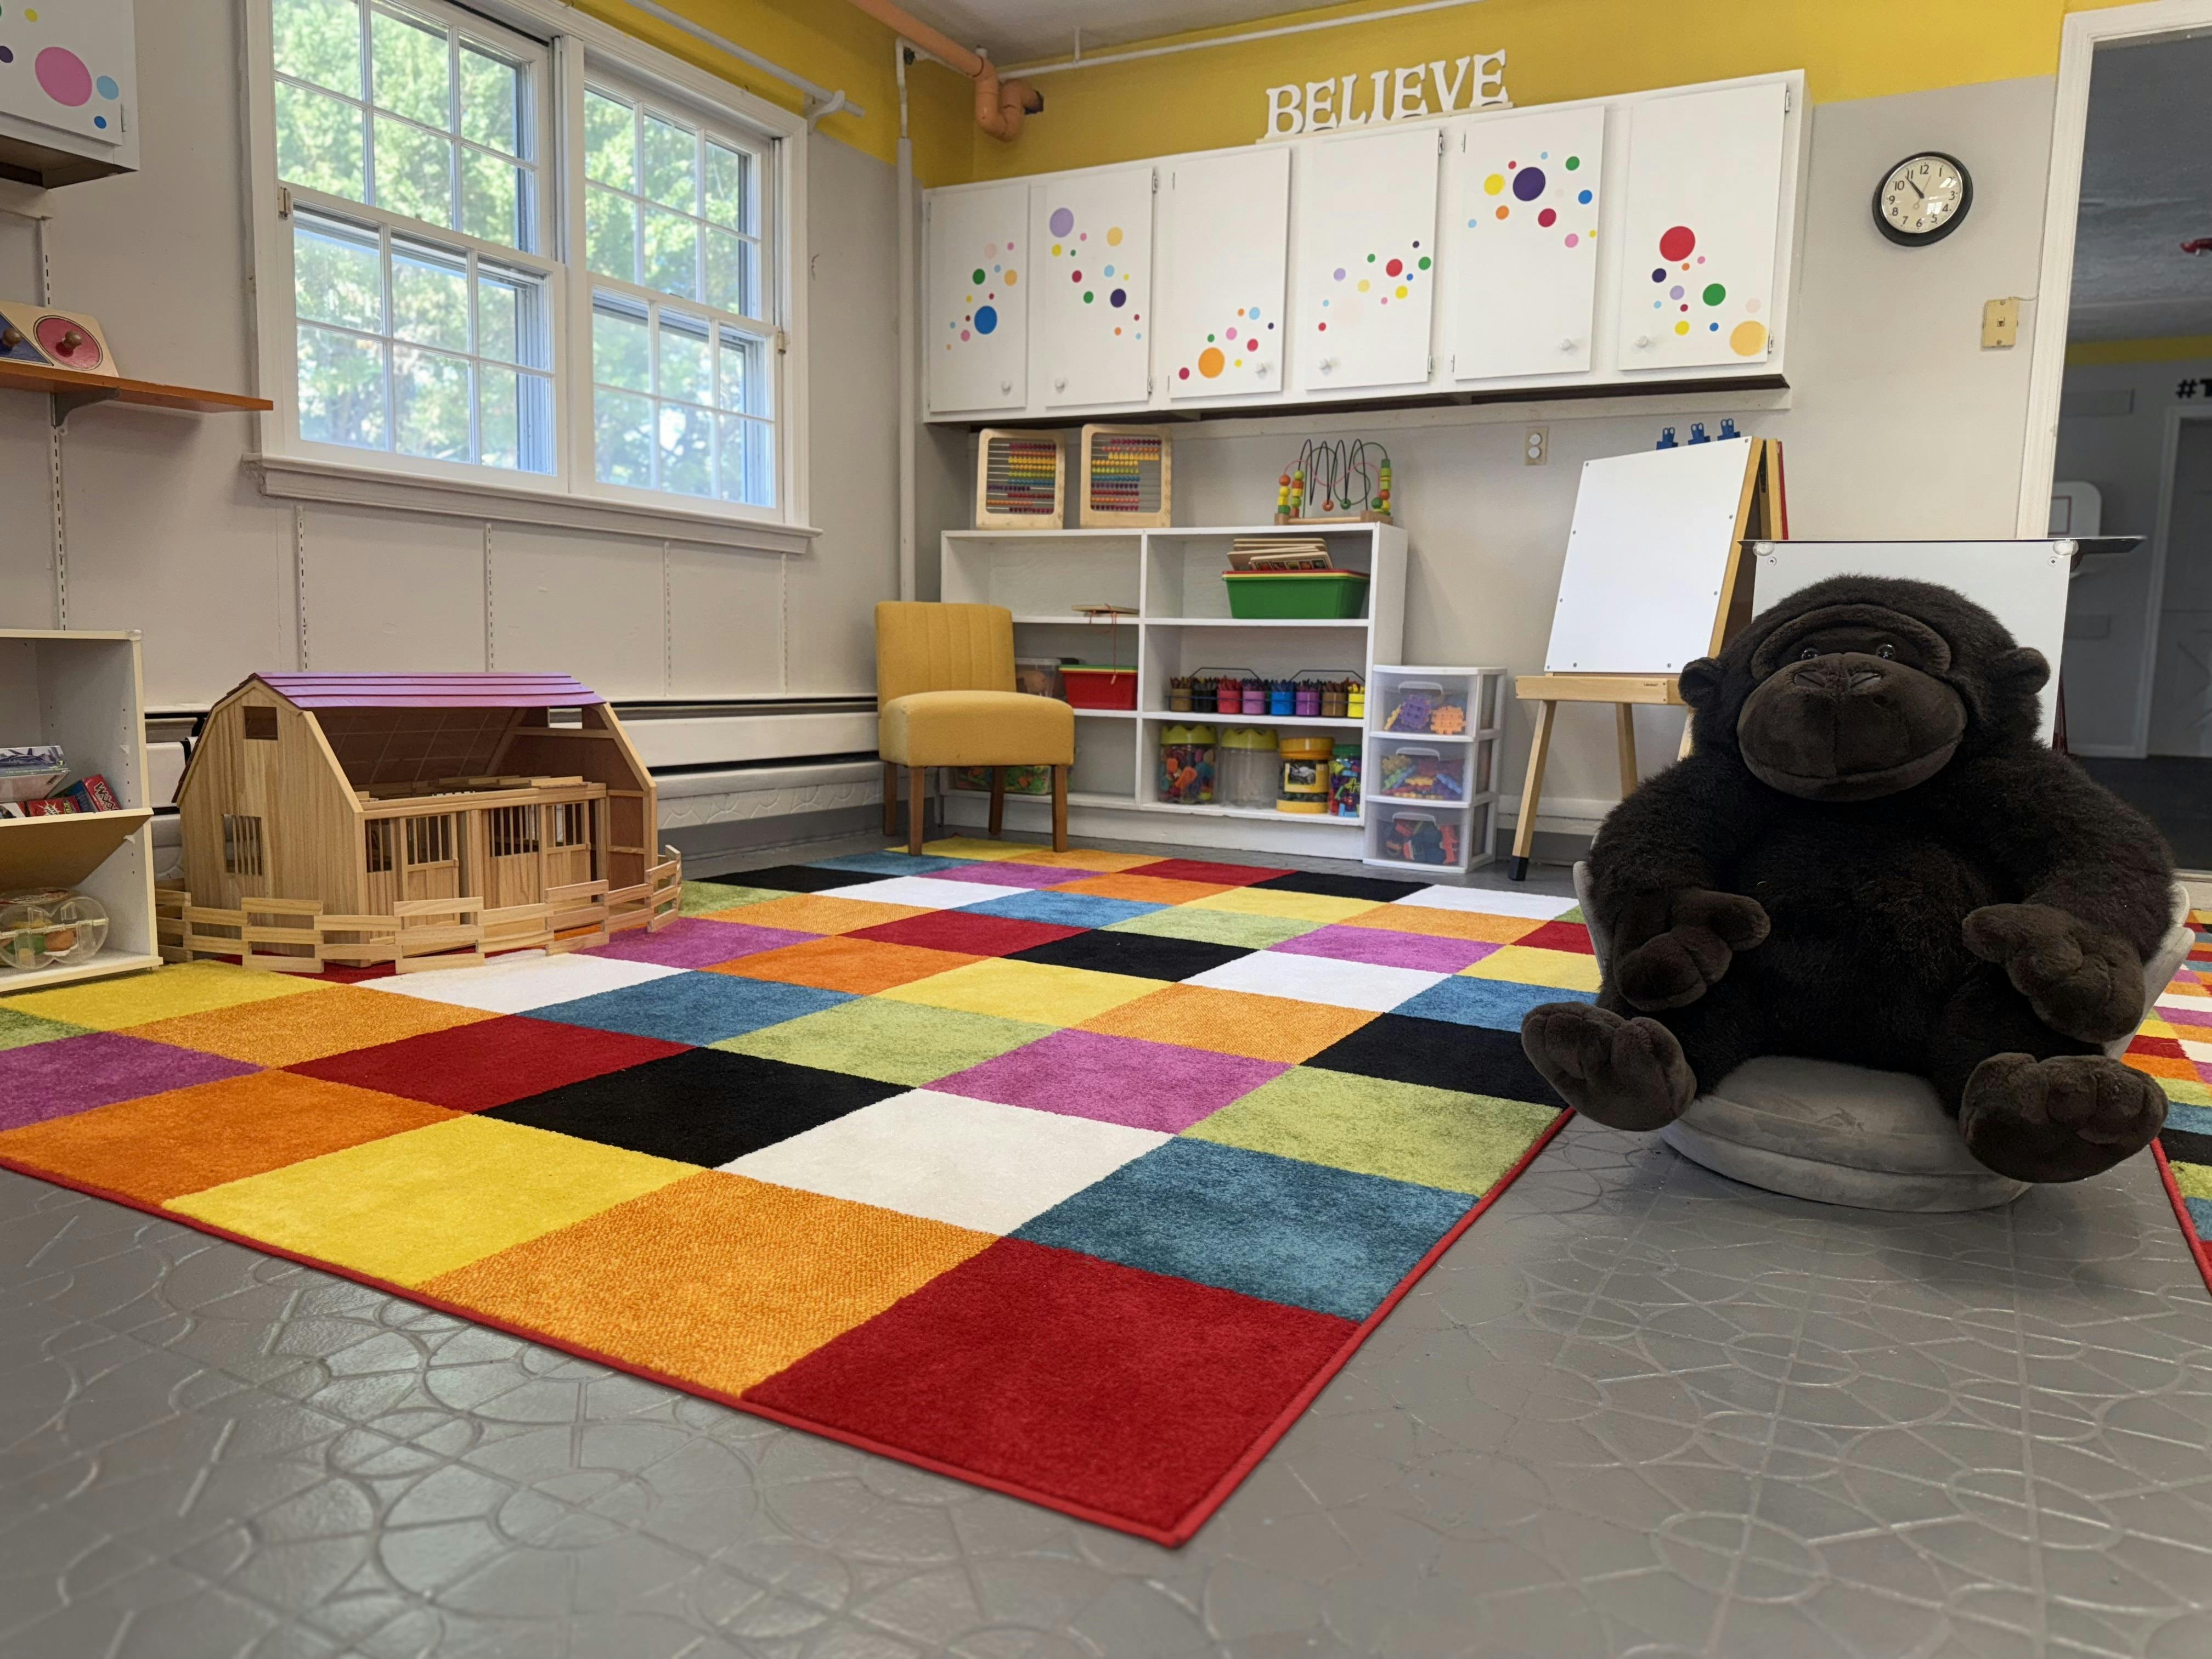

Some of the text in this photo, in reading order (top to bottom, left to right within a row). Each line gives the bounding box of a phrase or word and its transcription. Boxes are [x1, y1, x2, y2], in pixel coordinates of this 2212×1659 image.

[1264, 49, 1508, 138] BELIEVE
[1907, 170, 1914, 179] 11
[1920, 165, 1929, 175] 12
[1939, 167, 1943, 177] 1
[1894, 180, 1905, 191] 10
[1889, 195, 1895, 205] 9
[1949, 191, 1955, 200] 3
[1892, 207, 1898, 216] 8
[1942, 204, 1949, 212] 4
[1903, 216, 1909, 225] 7
[1916, 218, 1922, 227] 6
[1931, 214, 1938, 223] 5
